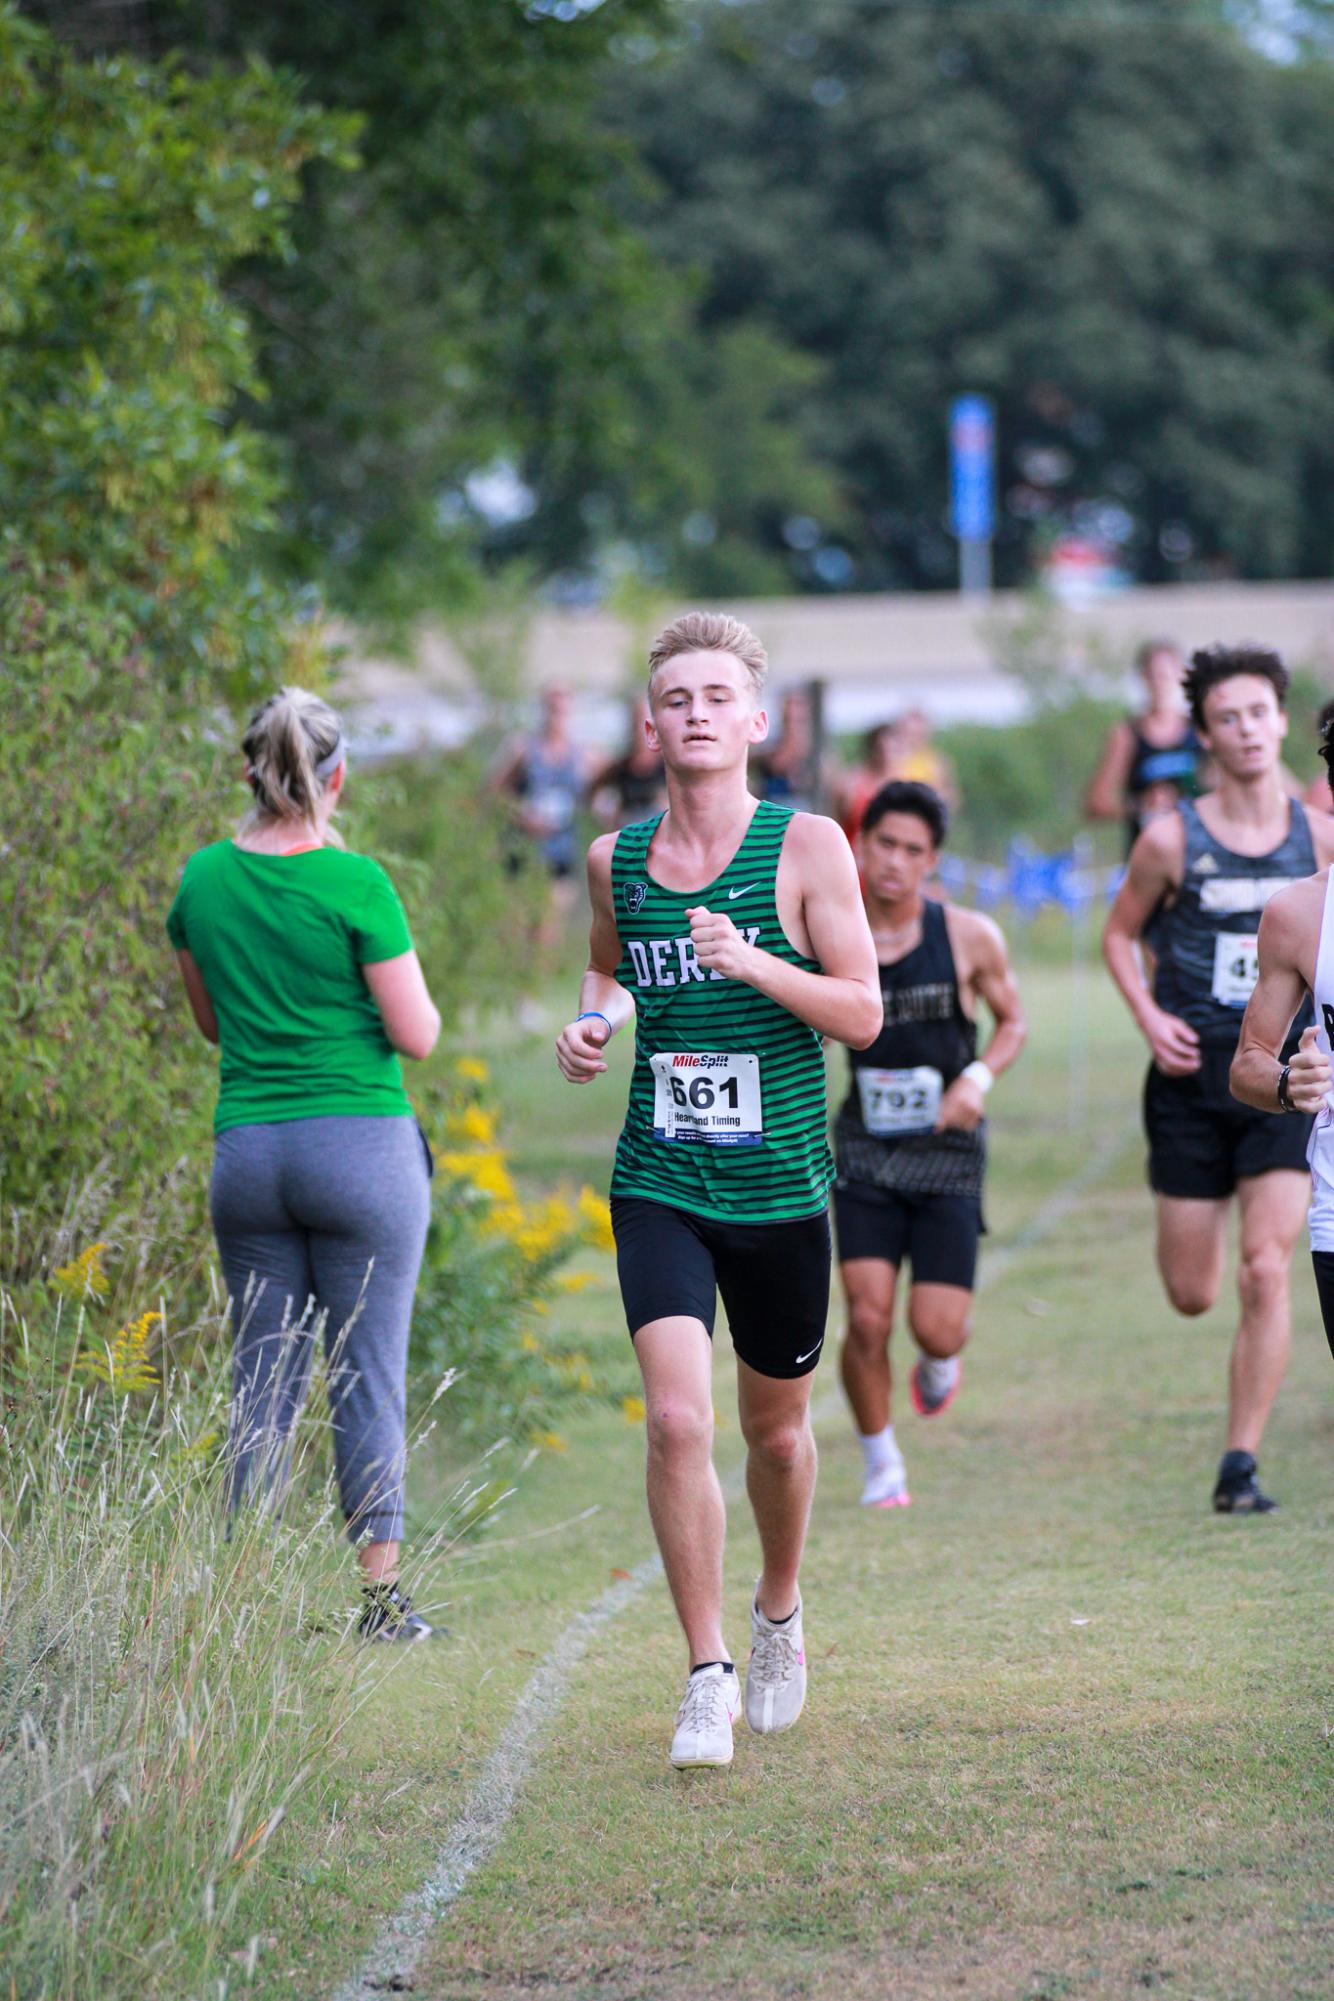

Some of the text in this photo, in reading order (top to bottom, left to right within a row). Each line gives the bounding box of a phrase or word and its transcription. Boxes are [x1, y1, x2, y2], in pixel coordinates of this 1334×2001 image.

[627, 926, 761, 988] DER
[672, 1055, 729, 1069] MileSplit
[669, 1076, 739, 1110] 661
[868, 1088, 928, 1112] 792
[674, 1111, 709, 1127] Hearand
[711, 1115, 741, 1127] Timing
